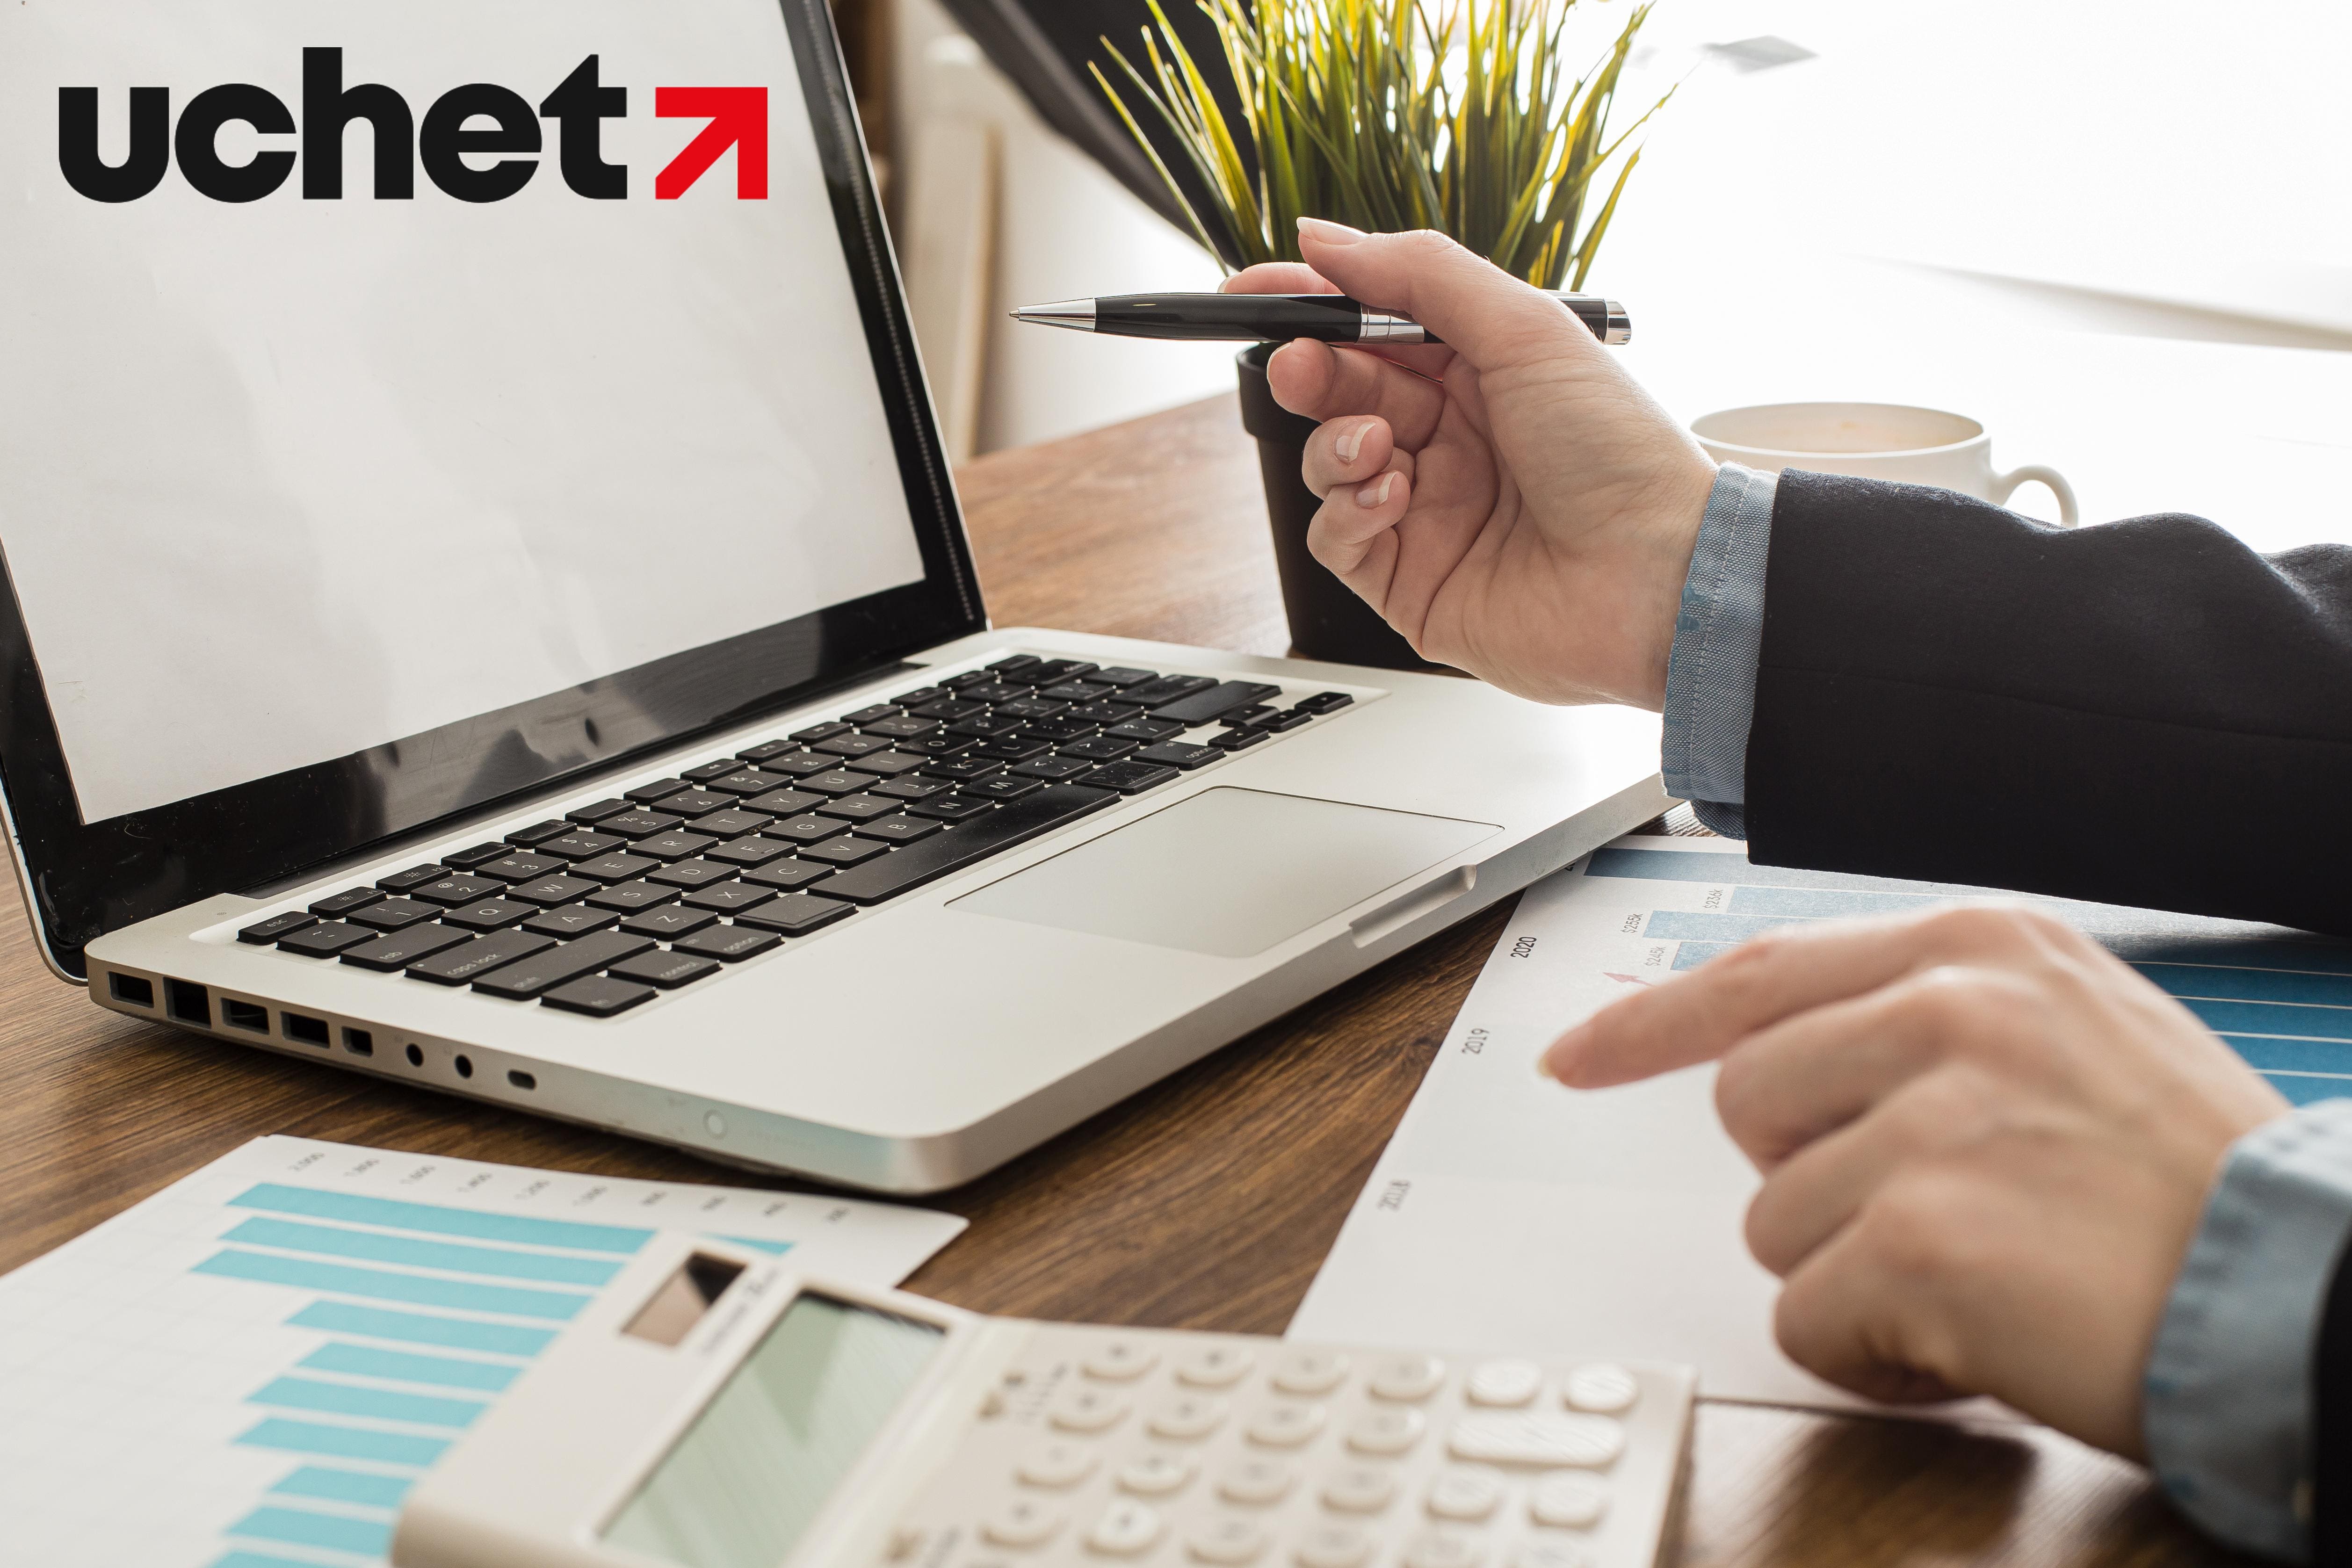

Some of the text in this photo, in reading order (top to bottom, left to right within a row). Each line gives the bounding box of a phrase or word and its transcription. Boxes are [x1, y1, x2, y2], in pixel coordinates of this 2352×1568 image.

[1186, 747, 1215, 758] option
[537, 884, 563, 893] W
[1703, 889, 1723, 909] $236k
[267, 918, 287, 927] esc
[1621, 913, 1643, 933] $255k
[379, 950, 402, 960] tab
[1511, 937, 1537, 958] 2020
[1643, 946, 1666, 966] $245k
[447, 954, 502, 975] caps lock
[1462, 1028, 1490, 1054] 2019
